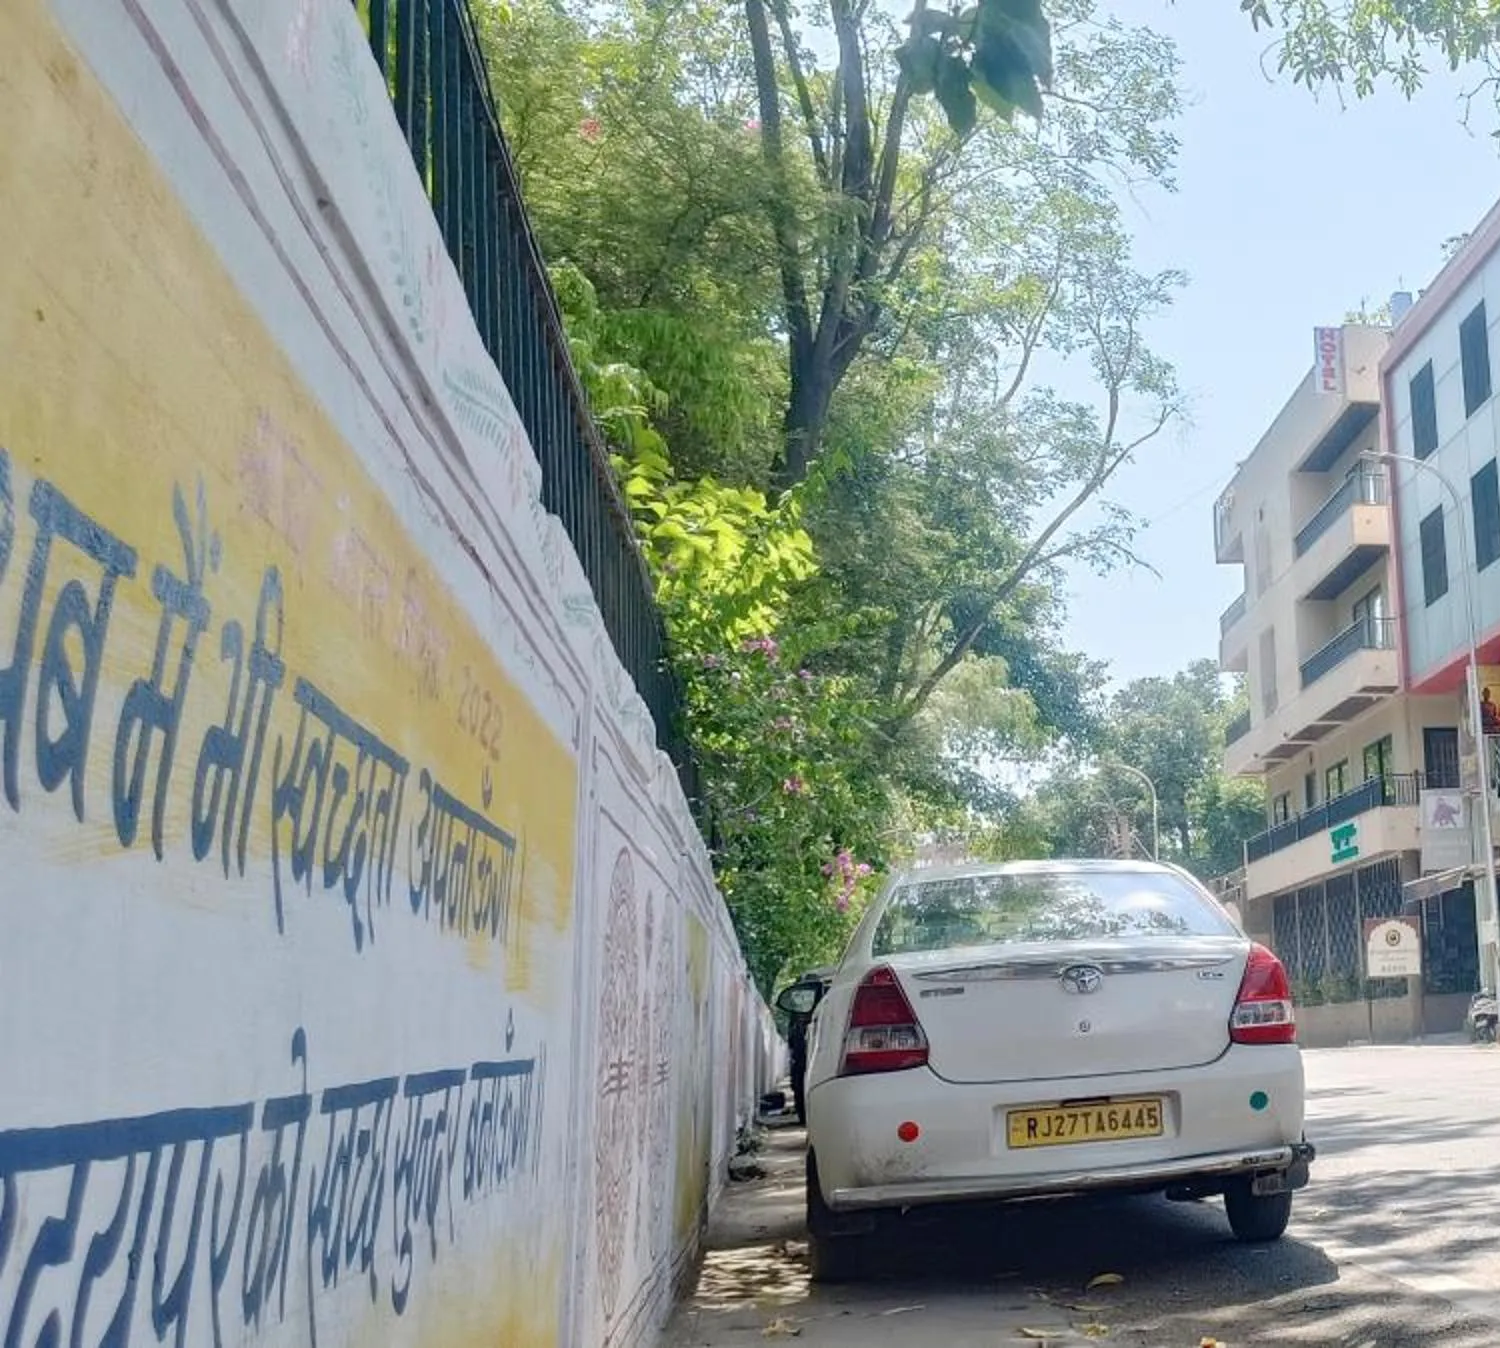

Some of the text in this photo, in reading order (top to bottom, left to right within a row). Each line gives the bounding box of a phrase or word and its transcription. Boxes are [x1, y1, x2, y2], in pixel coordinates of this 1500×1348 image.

[192, 564, 285, 881] भी
[272, 676, 410, 953] स्वच्छता
[242, 1026, 312, 1334] को
[1026, 1106, 1158, 1140] RJ27TA6445
